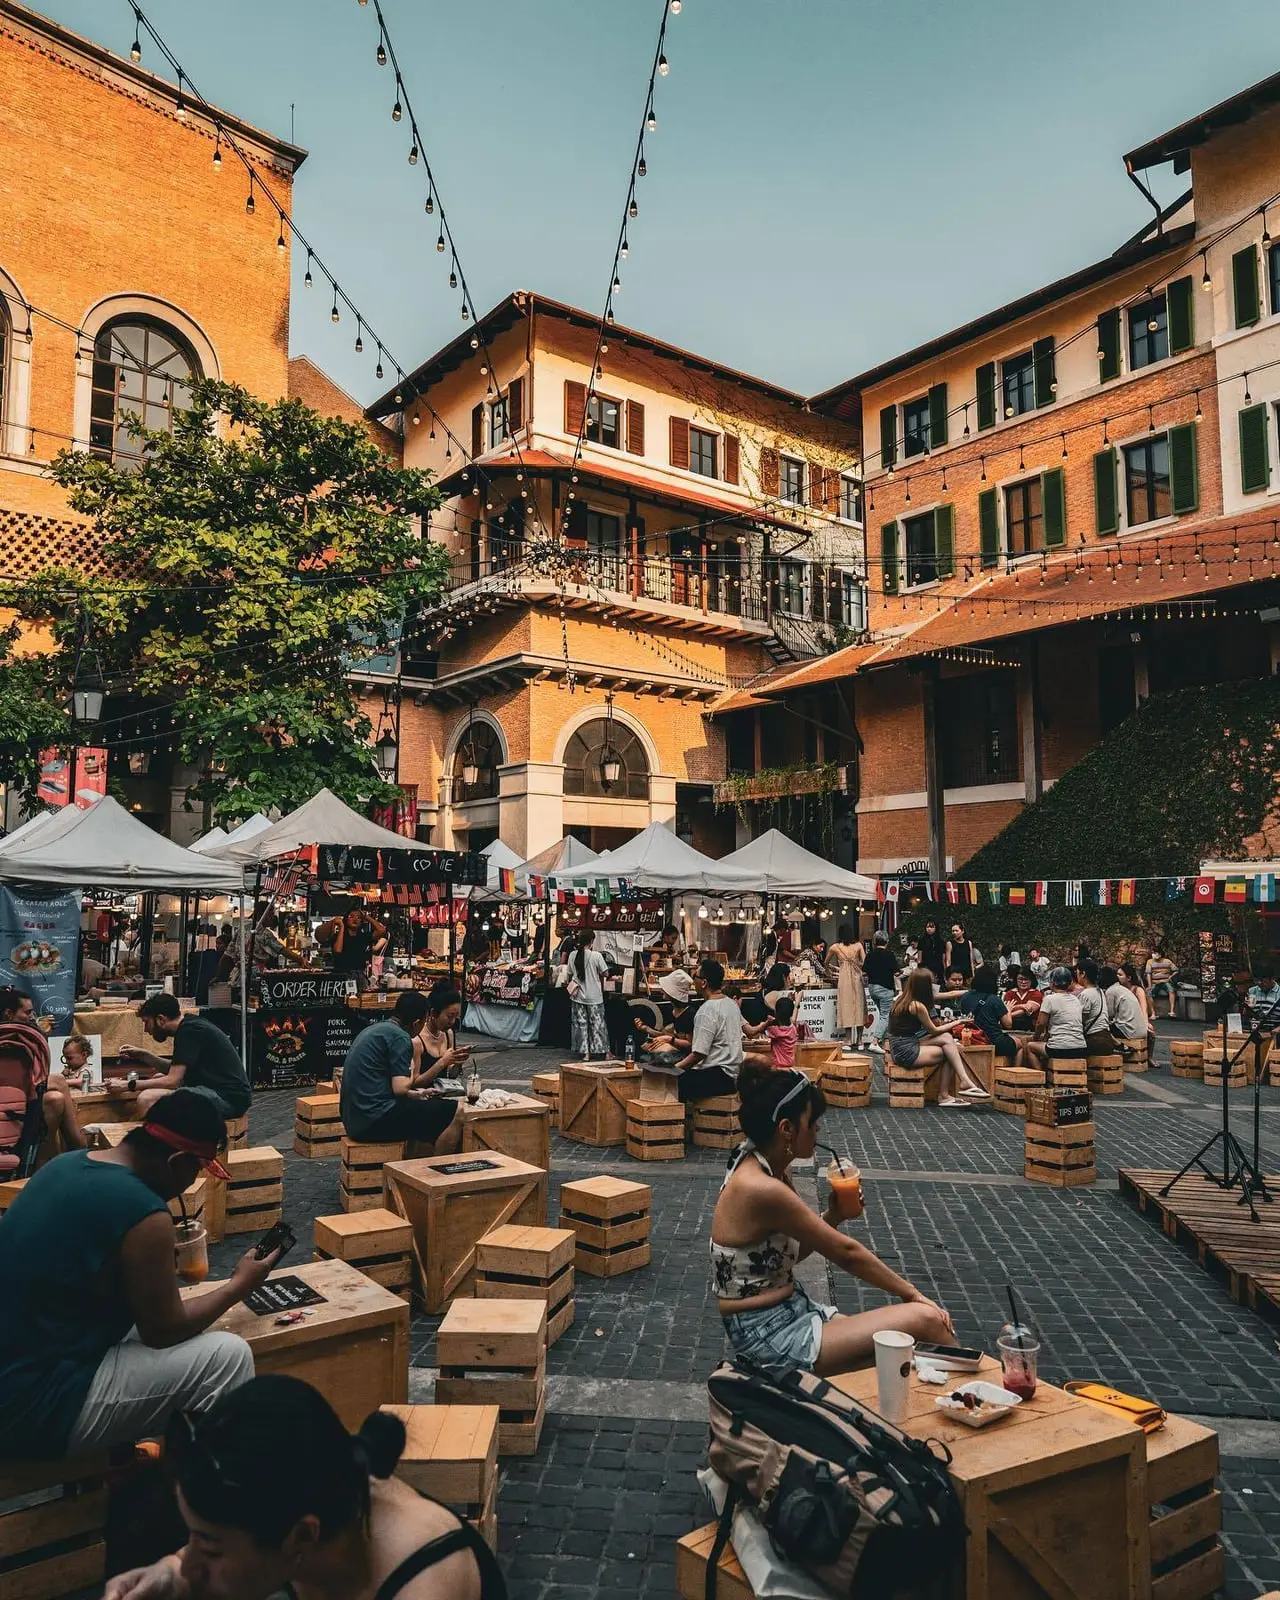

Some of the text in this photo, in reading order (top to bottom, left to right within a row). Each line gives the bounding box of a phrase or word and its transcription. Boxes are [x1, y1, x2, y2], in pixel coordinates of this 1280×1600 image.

[272, 980, 317, 998] ORDER
[320, 980, 347, 998] HERE
[327, 1018, 346, 1027] PORK
[1059, 1104, 1089, 1118] TIPS BOX
